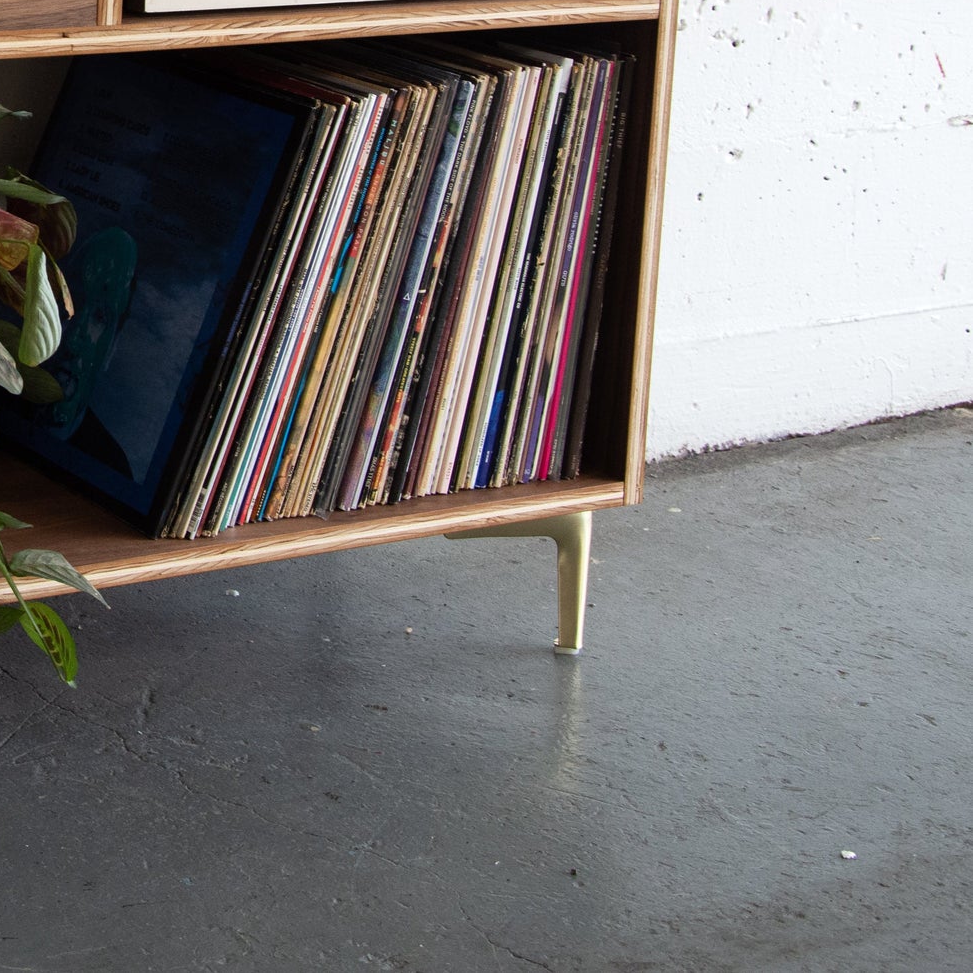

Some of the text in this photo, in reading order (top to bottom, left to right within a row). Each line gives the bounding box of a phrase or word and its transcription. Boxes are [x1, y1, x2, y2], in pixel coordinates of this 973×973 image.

[377, 118, 398, 165] MALIBU
[438, 98, 476, 220] PINK FLOYD THE DARK SIDE OF THE MOON
[360, 172, 381, 224] ANDERSON
[565, 210, 579, 252] olivia rodrigo
[559, 269, 568, 287] GUTS
